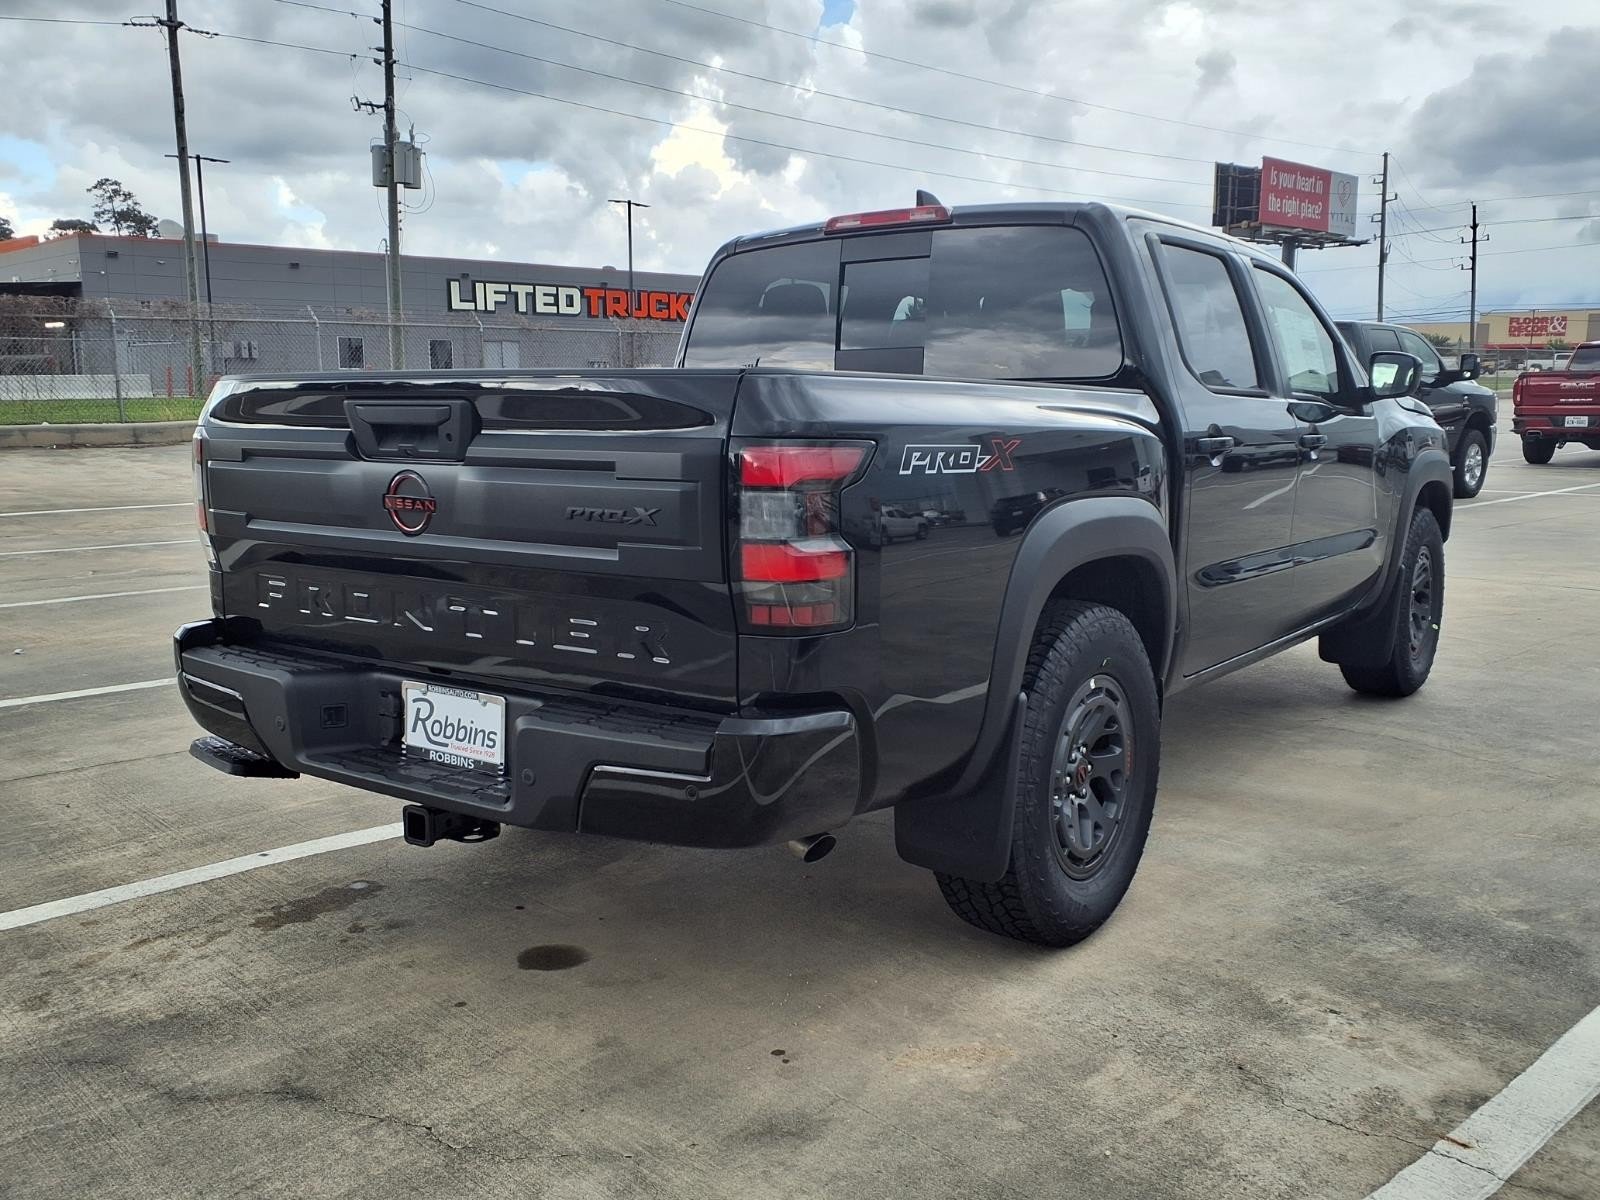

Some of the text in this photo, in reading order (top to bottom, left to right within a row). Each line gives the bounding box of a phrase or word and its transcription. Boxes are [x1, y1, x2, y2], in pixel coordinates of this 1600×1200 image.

[1270, 166, 1323, 195] Is your heart in
[1268, 192, 1322, 219] the right place?
[448, 279, 582, 316] LIFTED
[1509, 317, 1549, 325] FLOOR
[1509, 325, 1549, 333] DECOR
[384, 495, 436, 512] NISSAN
[257, 573, 671, 665] FRONTIER
[411, 697, 498, 749] Robbins
[429, 750, 475, 769] ROBBINS
[450, 742, 469, 752] Trusted
[469, 747, 483, 756] Since
